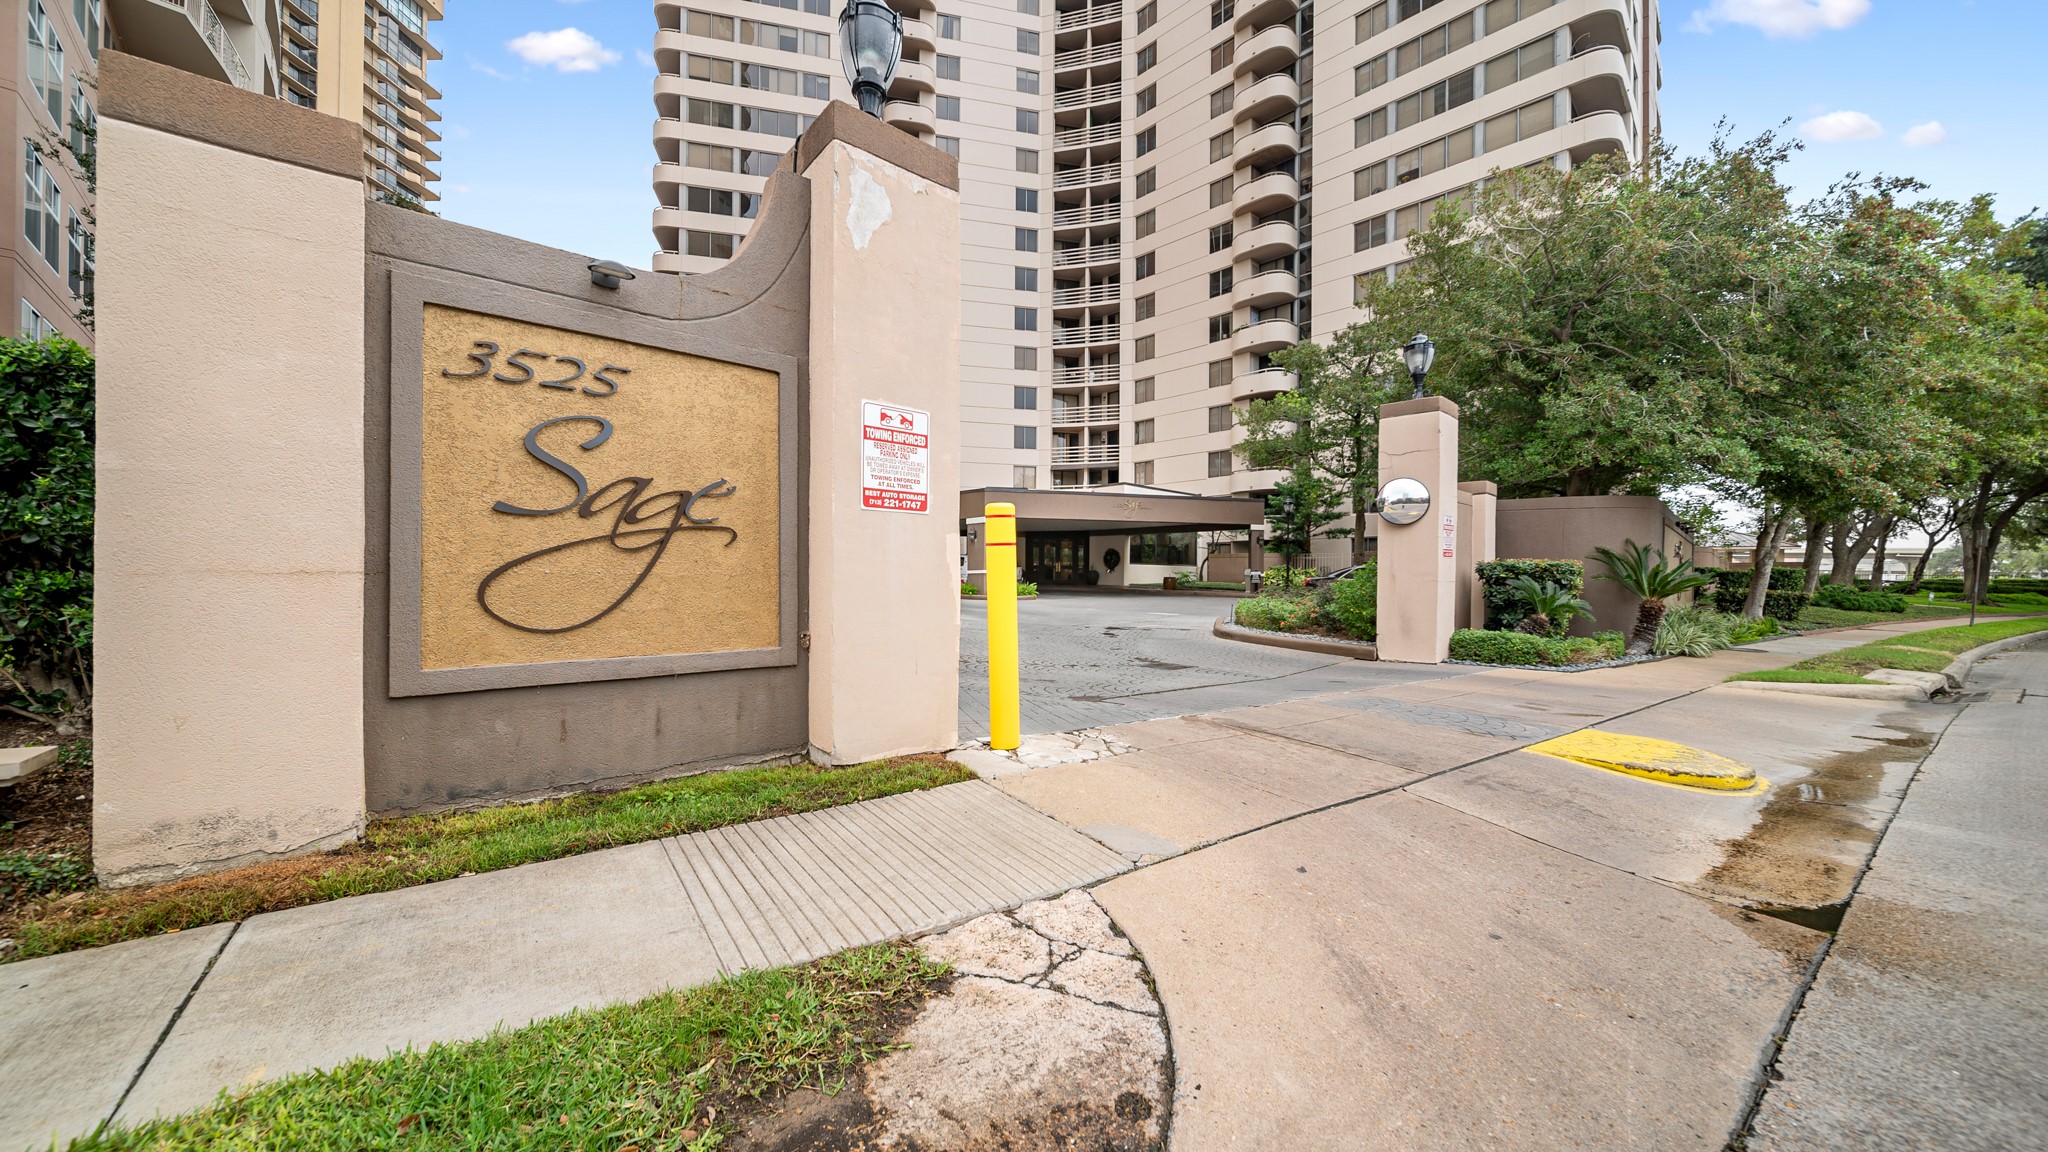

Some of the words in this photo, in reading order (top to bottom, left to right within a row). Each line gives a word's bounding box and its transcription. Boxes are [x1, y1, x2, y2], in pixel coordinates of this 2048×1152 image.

[442, 340, 631, 396] 3525
[866, 428, 892, 441] TOWING
[894, 432, 926, 445] ENFORCED
[874, 442, 896, 451] RESERVED
[897, 446, 918, 454] ASSIGNED
[880, 450, 898, 458] PARKING
[866, 456, 897, 464] UNAUTHORIZED
[884, 499, 921, 509] 221-1747
[477, 415, 738, 634] Sage
